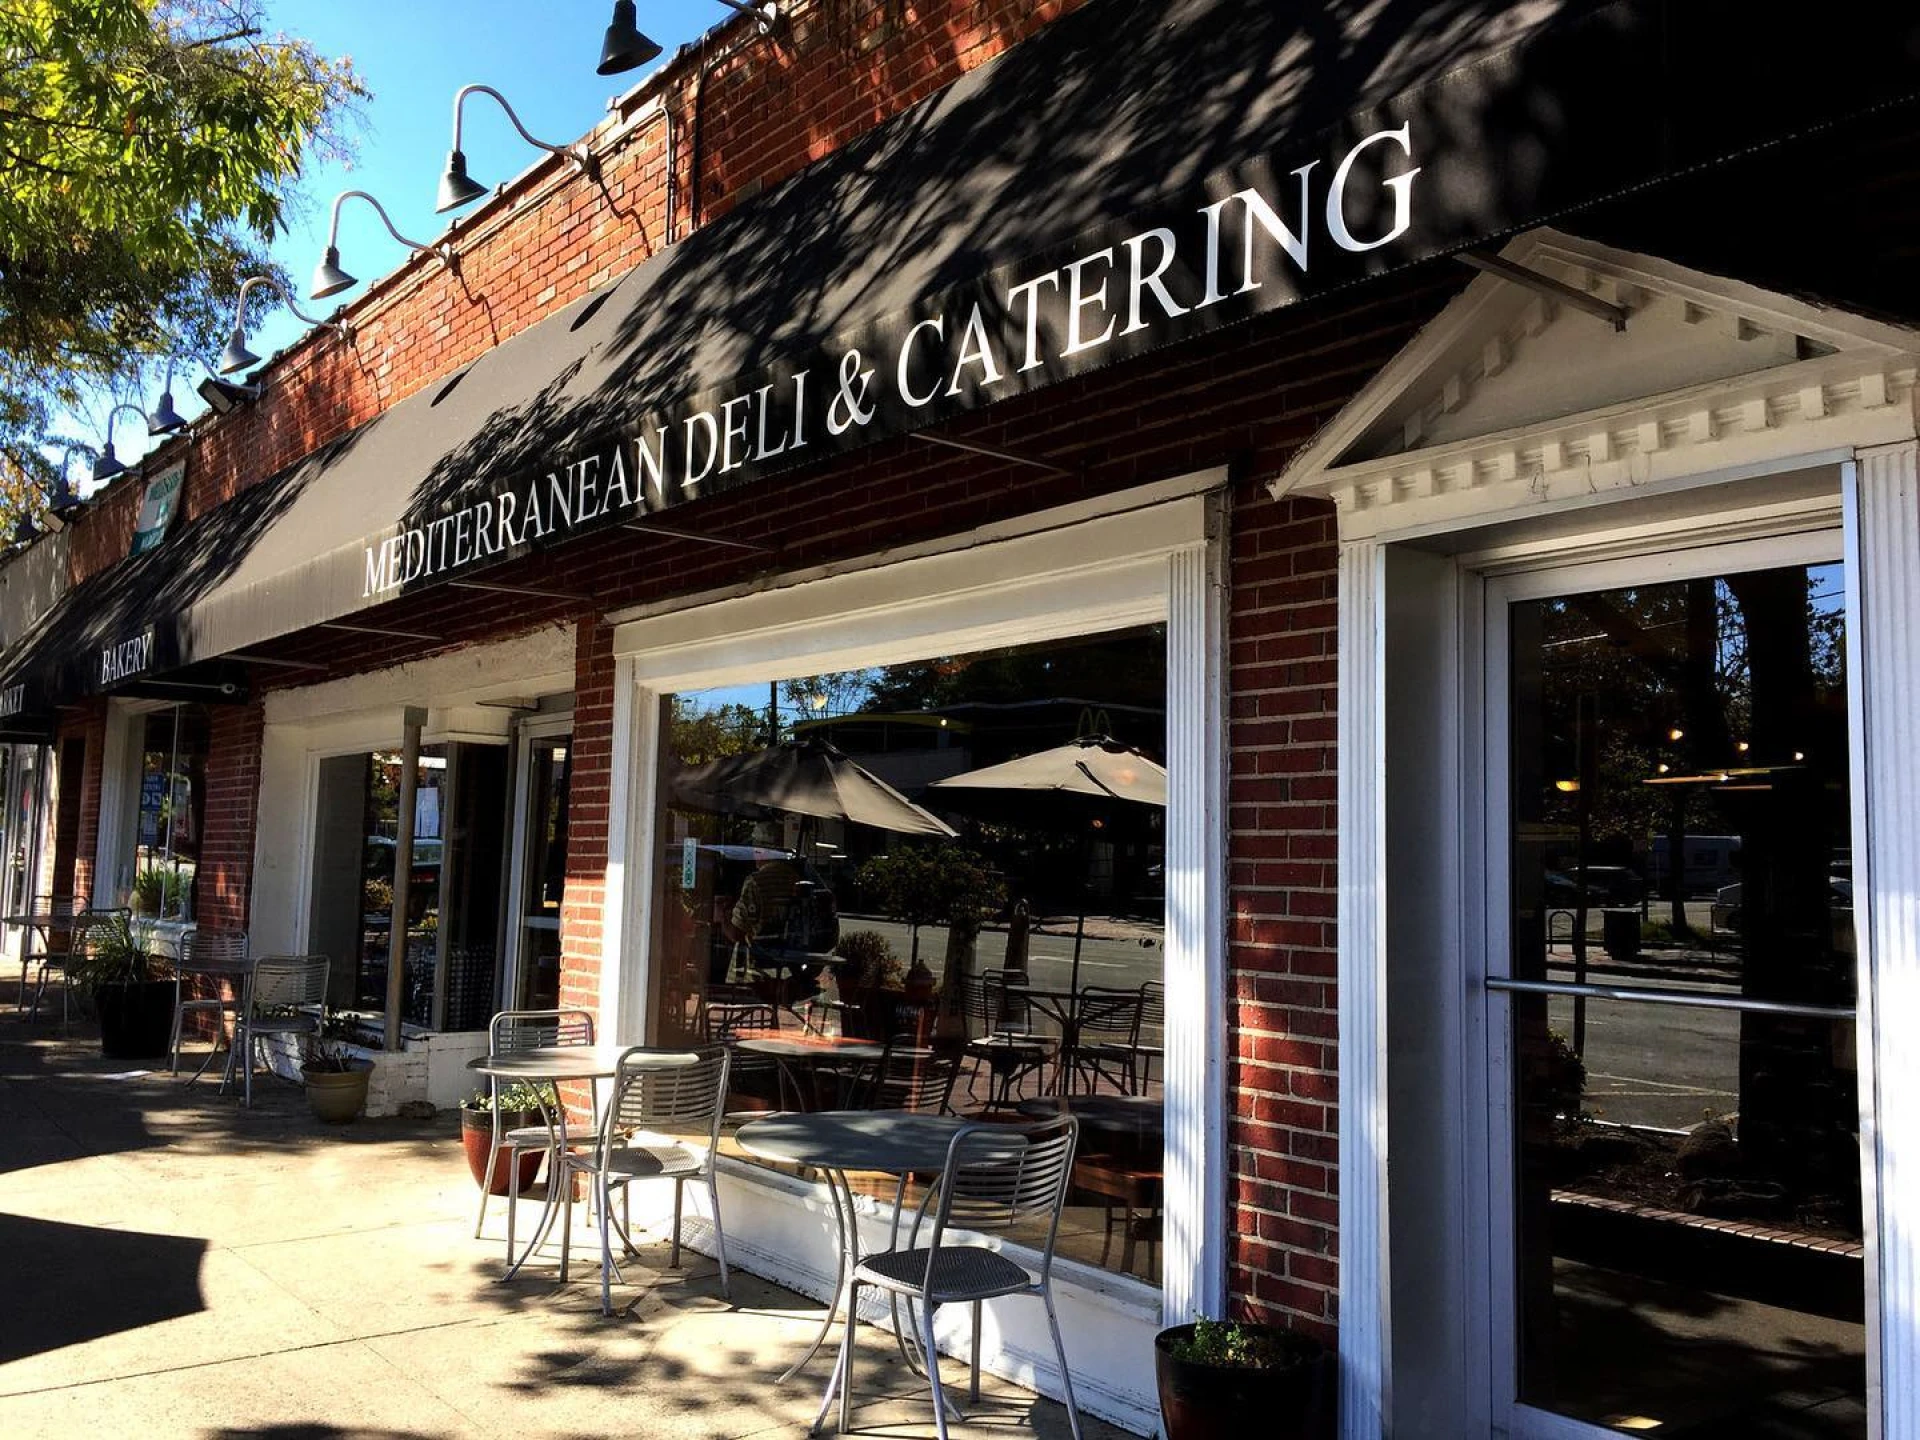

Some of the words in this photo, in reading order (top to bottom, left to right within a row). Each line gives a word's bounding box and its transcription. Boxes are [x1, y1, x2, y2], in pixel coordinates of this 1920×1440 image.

[362, 426, 667, 598] MEDITERRANEAN
[680, 370, 810, 488] DELI
[826, 349, 876, 436] &
[897, 119, 1421, 407] CATERING
[101, 632, 152, 684] BAKERY
